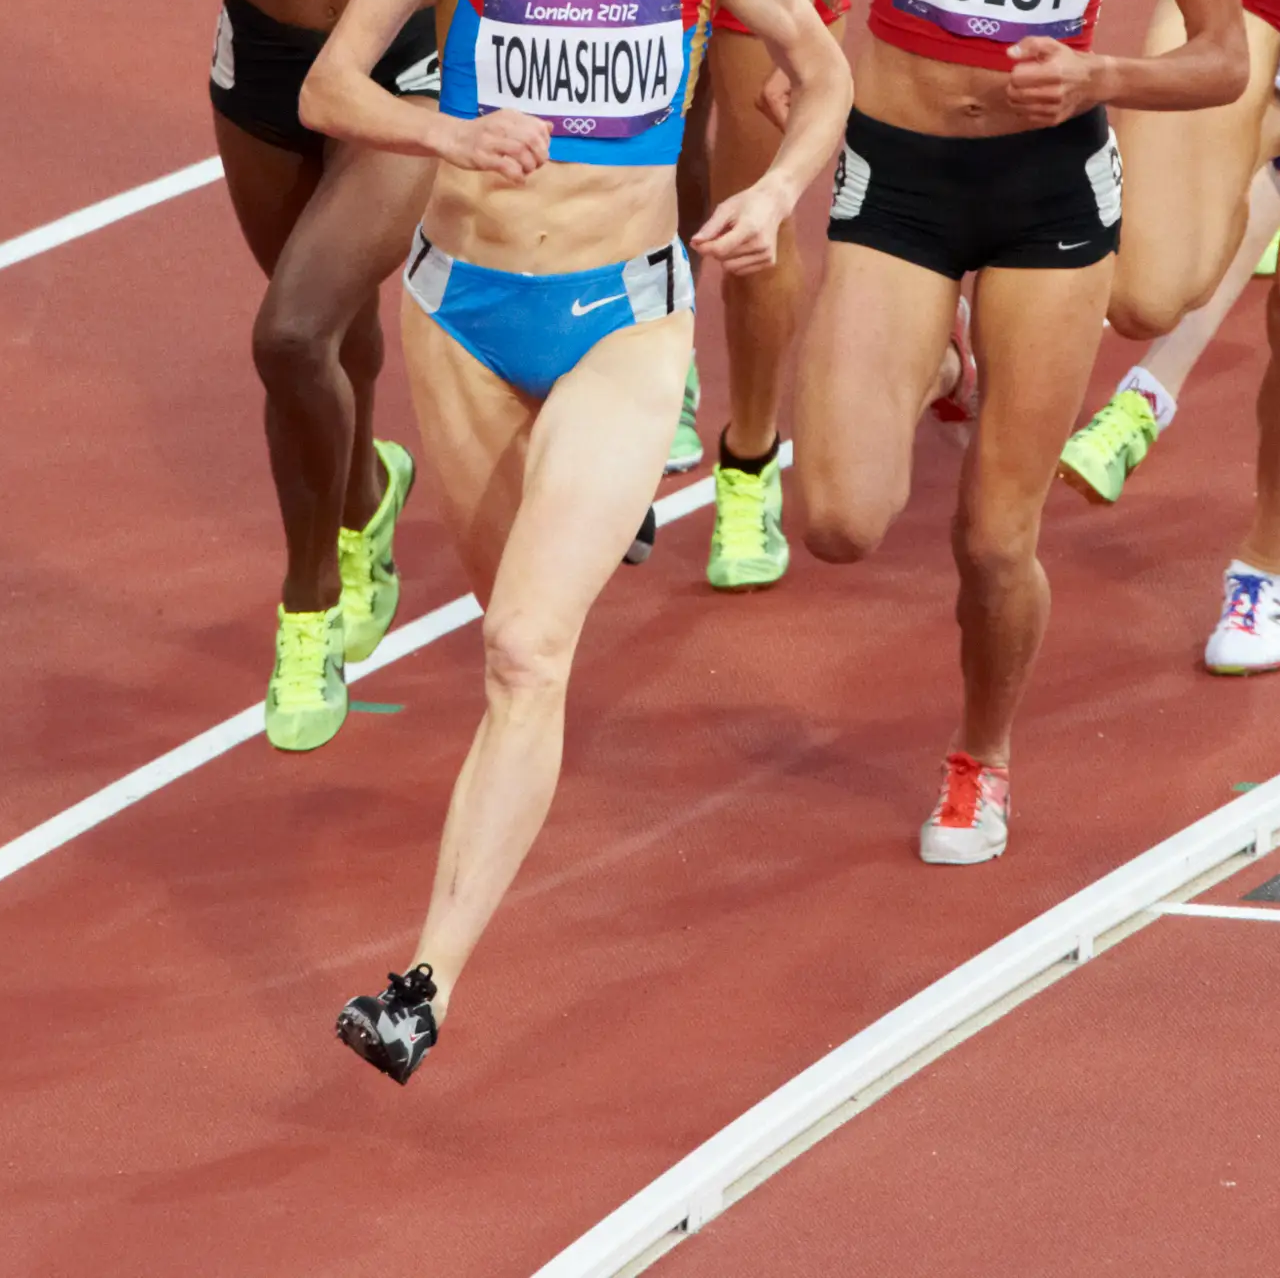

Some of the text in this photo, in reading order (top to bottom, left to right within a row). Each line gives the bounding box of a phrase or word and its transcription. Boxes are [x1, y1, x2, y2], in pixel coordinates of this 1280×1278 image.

[524, 1, 639, 22] London 2012
[491, 34, 668, 104] TOMASHOVA
[647, 244, 675, 315] 7
